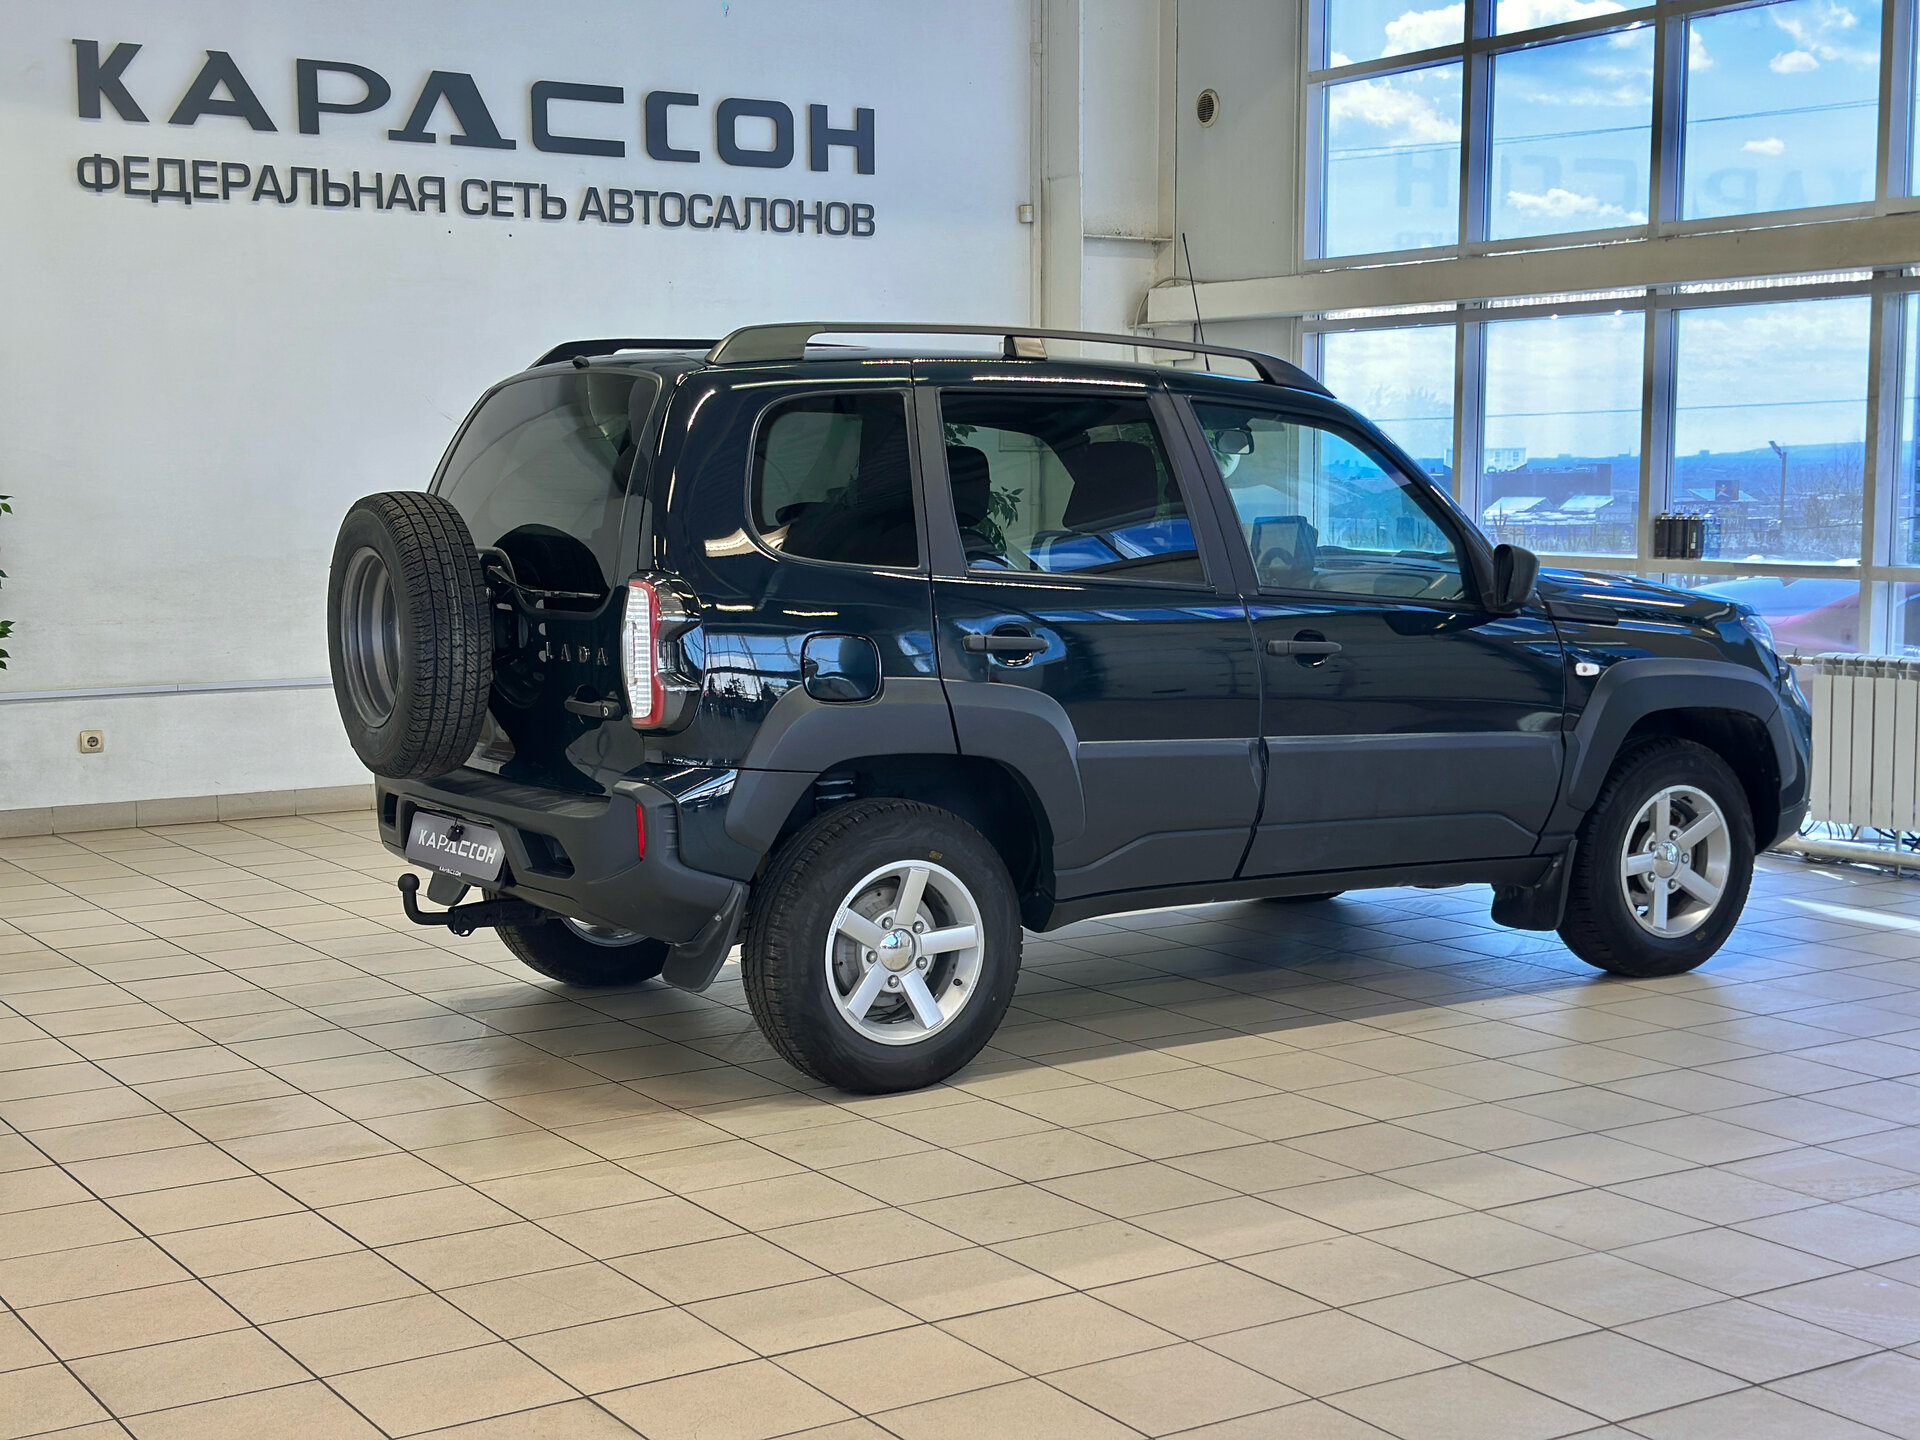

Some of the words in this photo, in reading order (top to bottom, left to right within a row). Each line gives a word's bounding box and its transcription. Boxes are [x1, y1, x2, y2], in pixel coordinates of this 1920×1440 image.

[76, 153, 446, 213] ФЕДЕРАЛЬНАЯ
[460, 178, 567, 220] СЕТЬ
[578, 186, 876, 237] АВТОСАЛОНОВ
